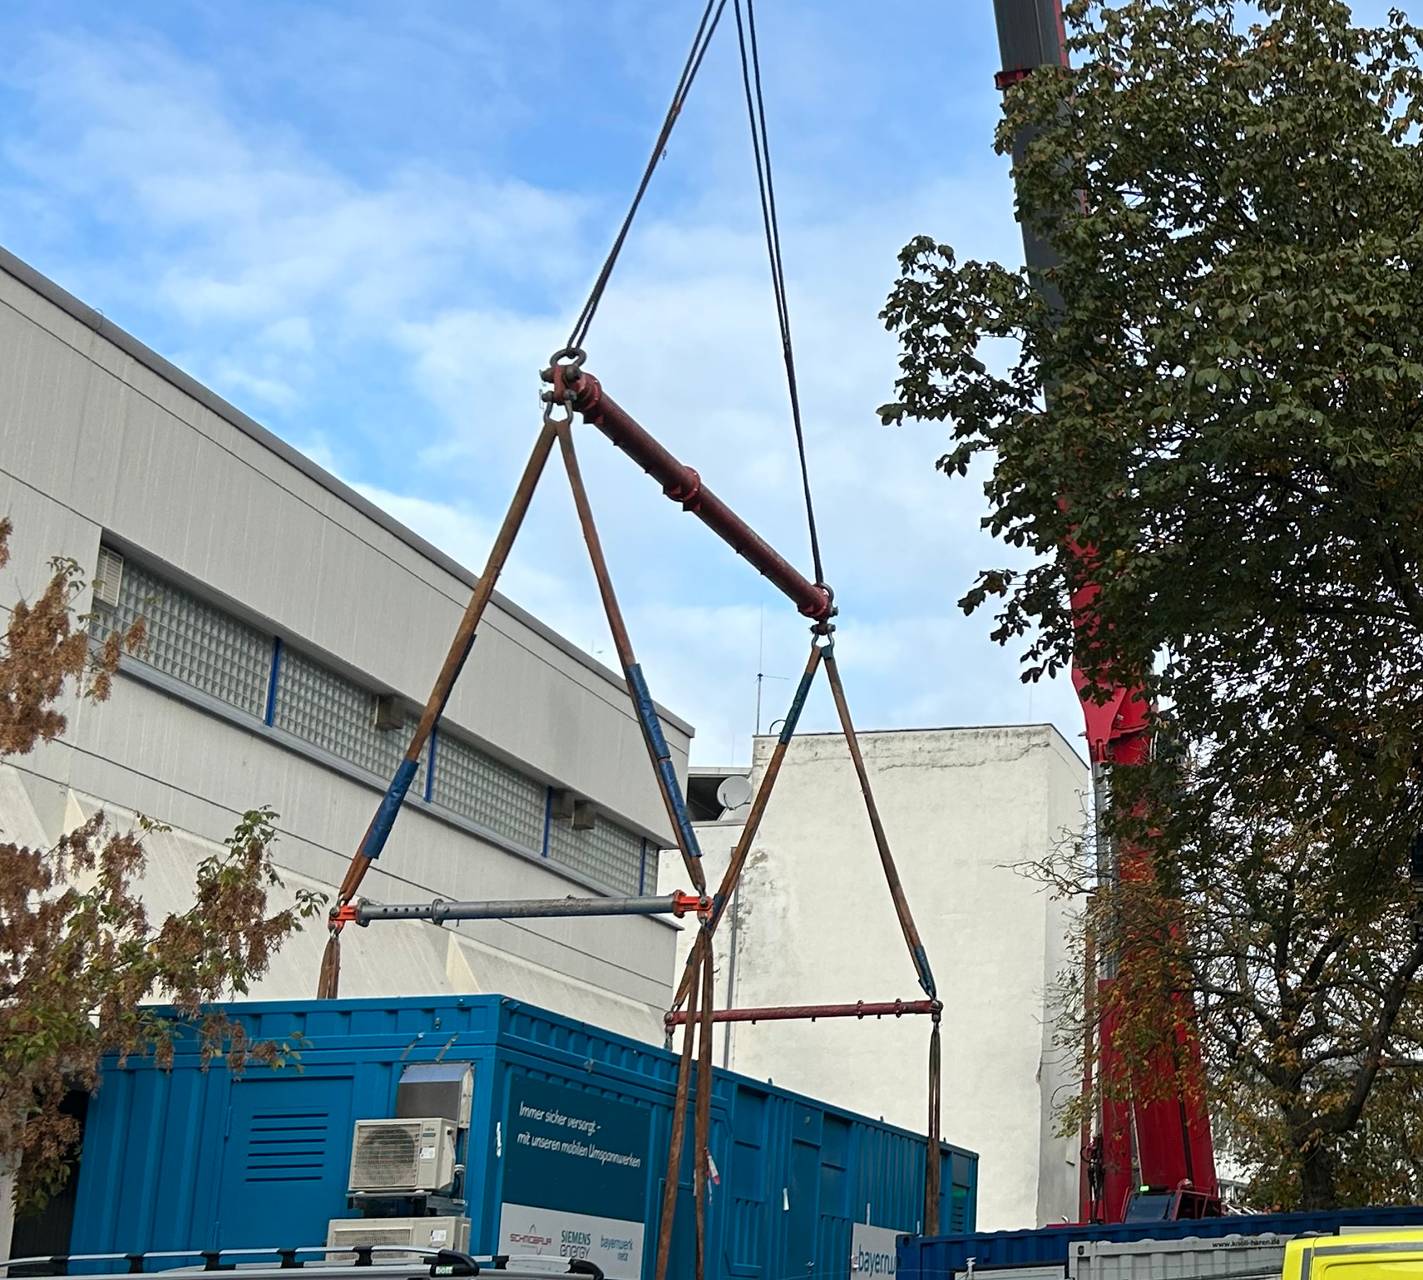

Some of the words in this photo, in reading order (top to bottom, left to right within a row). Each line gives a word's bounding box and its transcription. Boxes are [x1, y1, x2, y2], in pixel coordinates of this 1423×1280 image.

[519, 1100, 545, 1120] Immer
[545, 1109, 567, 1126] sicher
[567, 1116, 597, 1137] versorgt
[517, 1131, 531, 1146] mit
[531, 1136, 561, 1151] unseren
[561, 1140, 588, 1157] mobilen
[588, 1143, 641, 1168] Umspannwerken
[561, 1230, 591, 1246] SIEMENS
